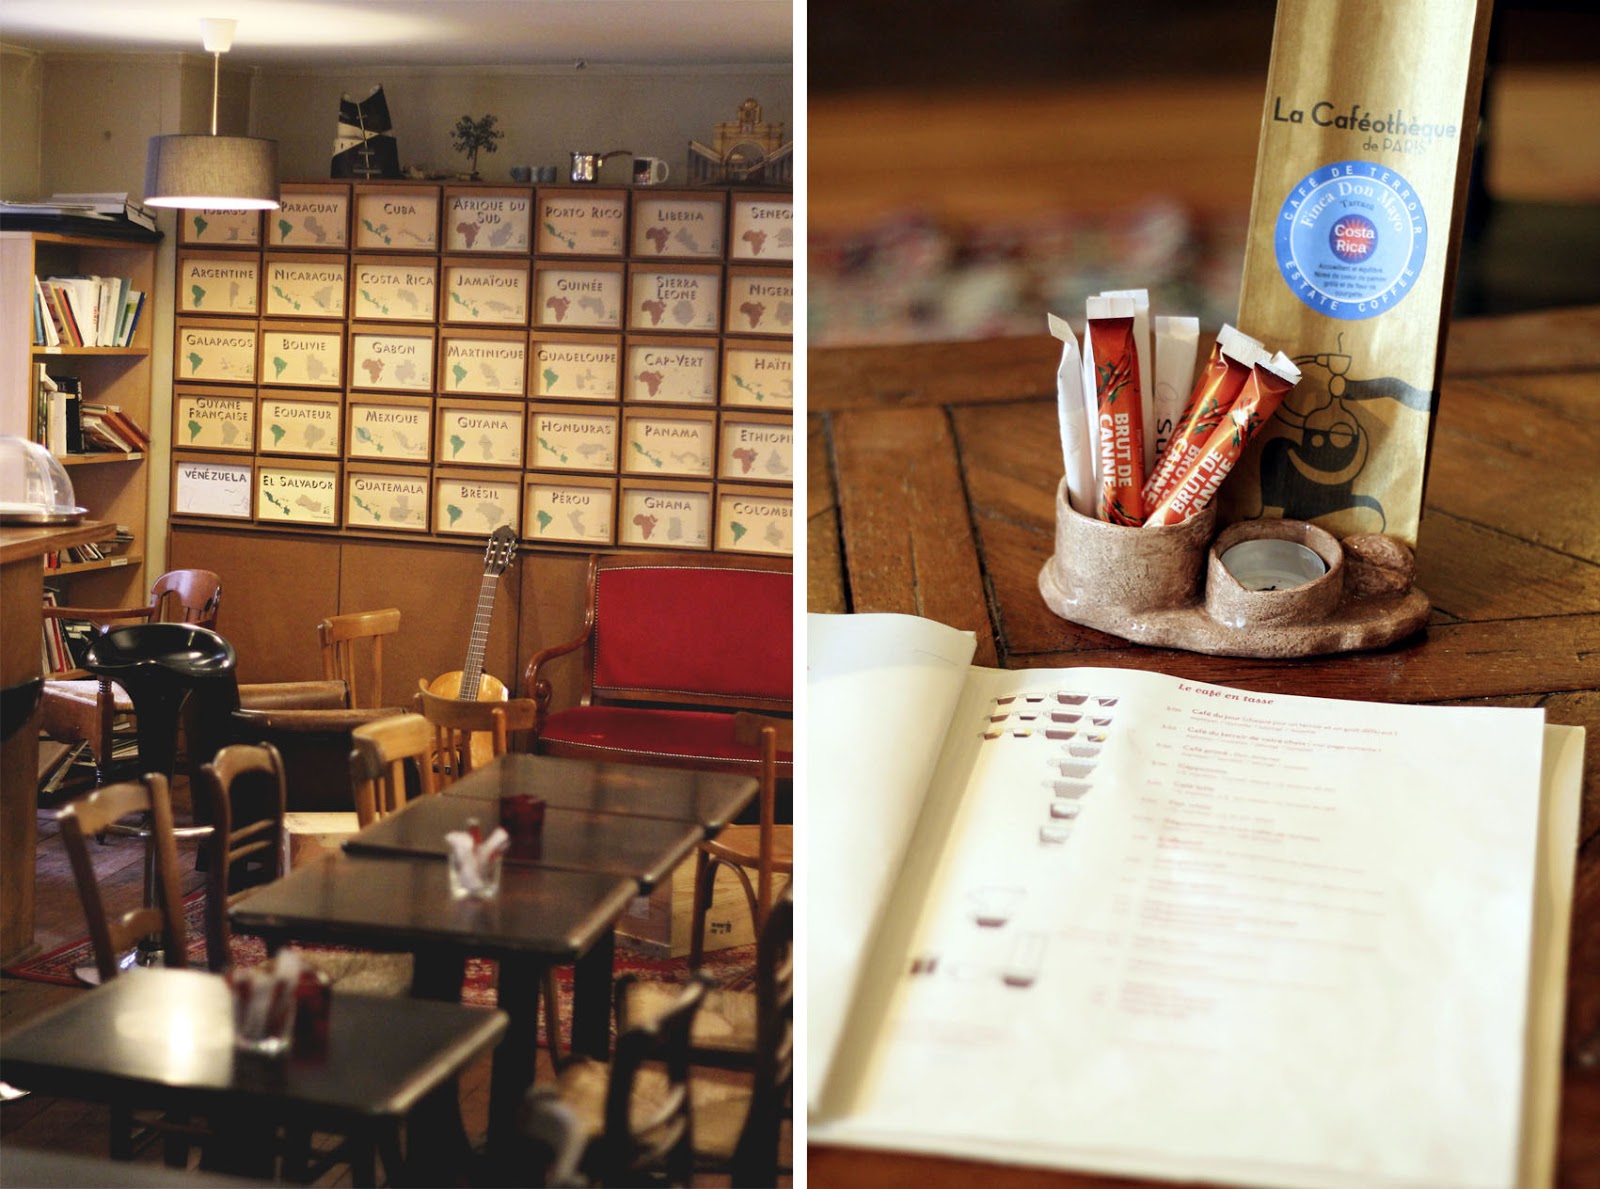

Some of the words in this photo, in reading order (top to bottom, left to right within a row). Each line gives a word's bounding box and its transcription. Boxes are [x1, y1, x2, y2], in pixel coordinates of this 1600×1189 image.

[1274, 96, 1304, 124] La
[1312, 101, 1458, 144] Caféothèque
[1362, 136, 1379, 152] de
[1383, 137, 1427, 155] PARIS
[453, 199, 504, 212] AFRIQUE
[509, 200, 525, 211] DU
[1284, 177, 1318, 221] CAFÉ
[1331, 165, 1354, 178] DE
[1370, 167, 1423, 234] TERROIR
[1300, 191, 1336, 229] Finca
[1338, 181, 1374, 197] Don
[1376, 189, 1405, 232] Mayo
[280, 201, 338, 214] PARAGUAY
[383, 203, 416, 215] CUBA
[545, 206, 585, 219] PORTO
[591, 207, 622, 219] RICO
[751, 206, 793, 219] SENEG
[477, 211, 501, 225] SUD
[657, 209, 704, 222] LIBERIA
[1334, 223, 1375, 240] Costa
[1336, 239, 1367, 254] Rica
[190, 267, 254, 280] ARGENTINE
[274, 269, 344, 283] NICARAGUA
[360, 272, 400, 286] COSTA
[406, 274, 434, 287] RICA
[456, 273, 519, 288] JAMAÏQUE
[557, 277, 603, 292] GUINÉE
[656, 276, 699, 289] SIERRA
[1285, 260, 1339, 310] ESTATE
[1358, 267, 1415, 313] COFFEE
[657, 288, 696, 300] LEONE
[186, 334, 253, 349] GALAPAGOS
[282, 339, 327, 351] BOLIVIE
[371, 341, 415, 355] GABON
[447, 345, 525, 361] MARTINIQUE
[537, 349, 617, 364] GUADELOUPE
[644, 353, 704, 368] CAP-VERT
[754, 357, 792, 371] HAÏTI
[196, 397, 241, 410] GUYANE
[188, 407, 248, 422] FRANÇAISE
[274, 406, 332, 420] EQUATEUR
[365, 410, 418, 425] MEXIQUE
[457, 416, 509, 430] GUYANA
[541, 420, 612, 435] HONDURAS
[644, 425, 700, 439] PANAMA
[740, 429, 793, 444] ETHIOPI
[1114, 413, 1131, 462] BRUT
[1099, 414, 1117, 488] CANNE
[185, 467, 248, 483] VÉNÉZUELA
[1118, 465, 1132, 487] DE
[1170, 465, 1206, 514] BRUT
[1201, 447, 1223, 473] DE
[263, 475, 275, 487] EL
[280, 475, 334, 491] SALVADOR
[354, 479, 424, 494] GUATEMALA
[1184, 458, 1232, 520] CANNE
[460, 485, 500, 500] BRÉSIL
[551, 490, 590, 506] PÉROU
[644, 496, 692, 511] GHANA
[1178, 683, 1192, 692] Le
[1195, 687, 1222, 697] café
[1224, 693, 1239, 701] en
[1243, 695, 1274, 705] tasse
